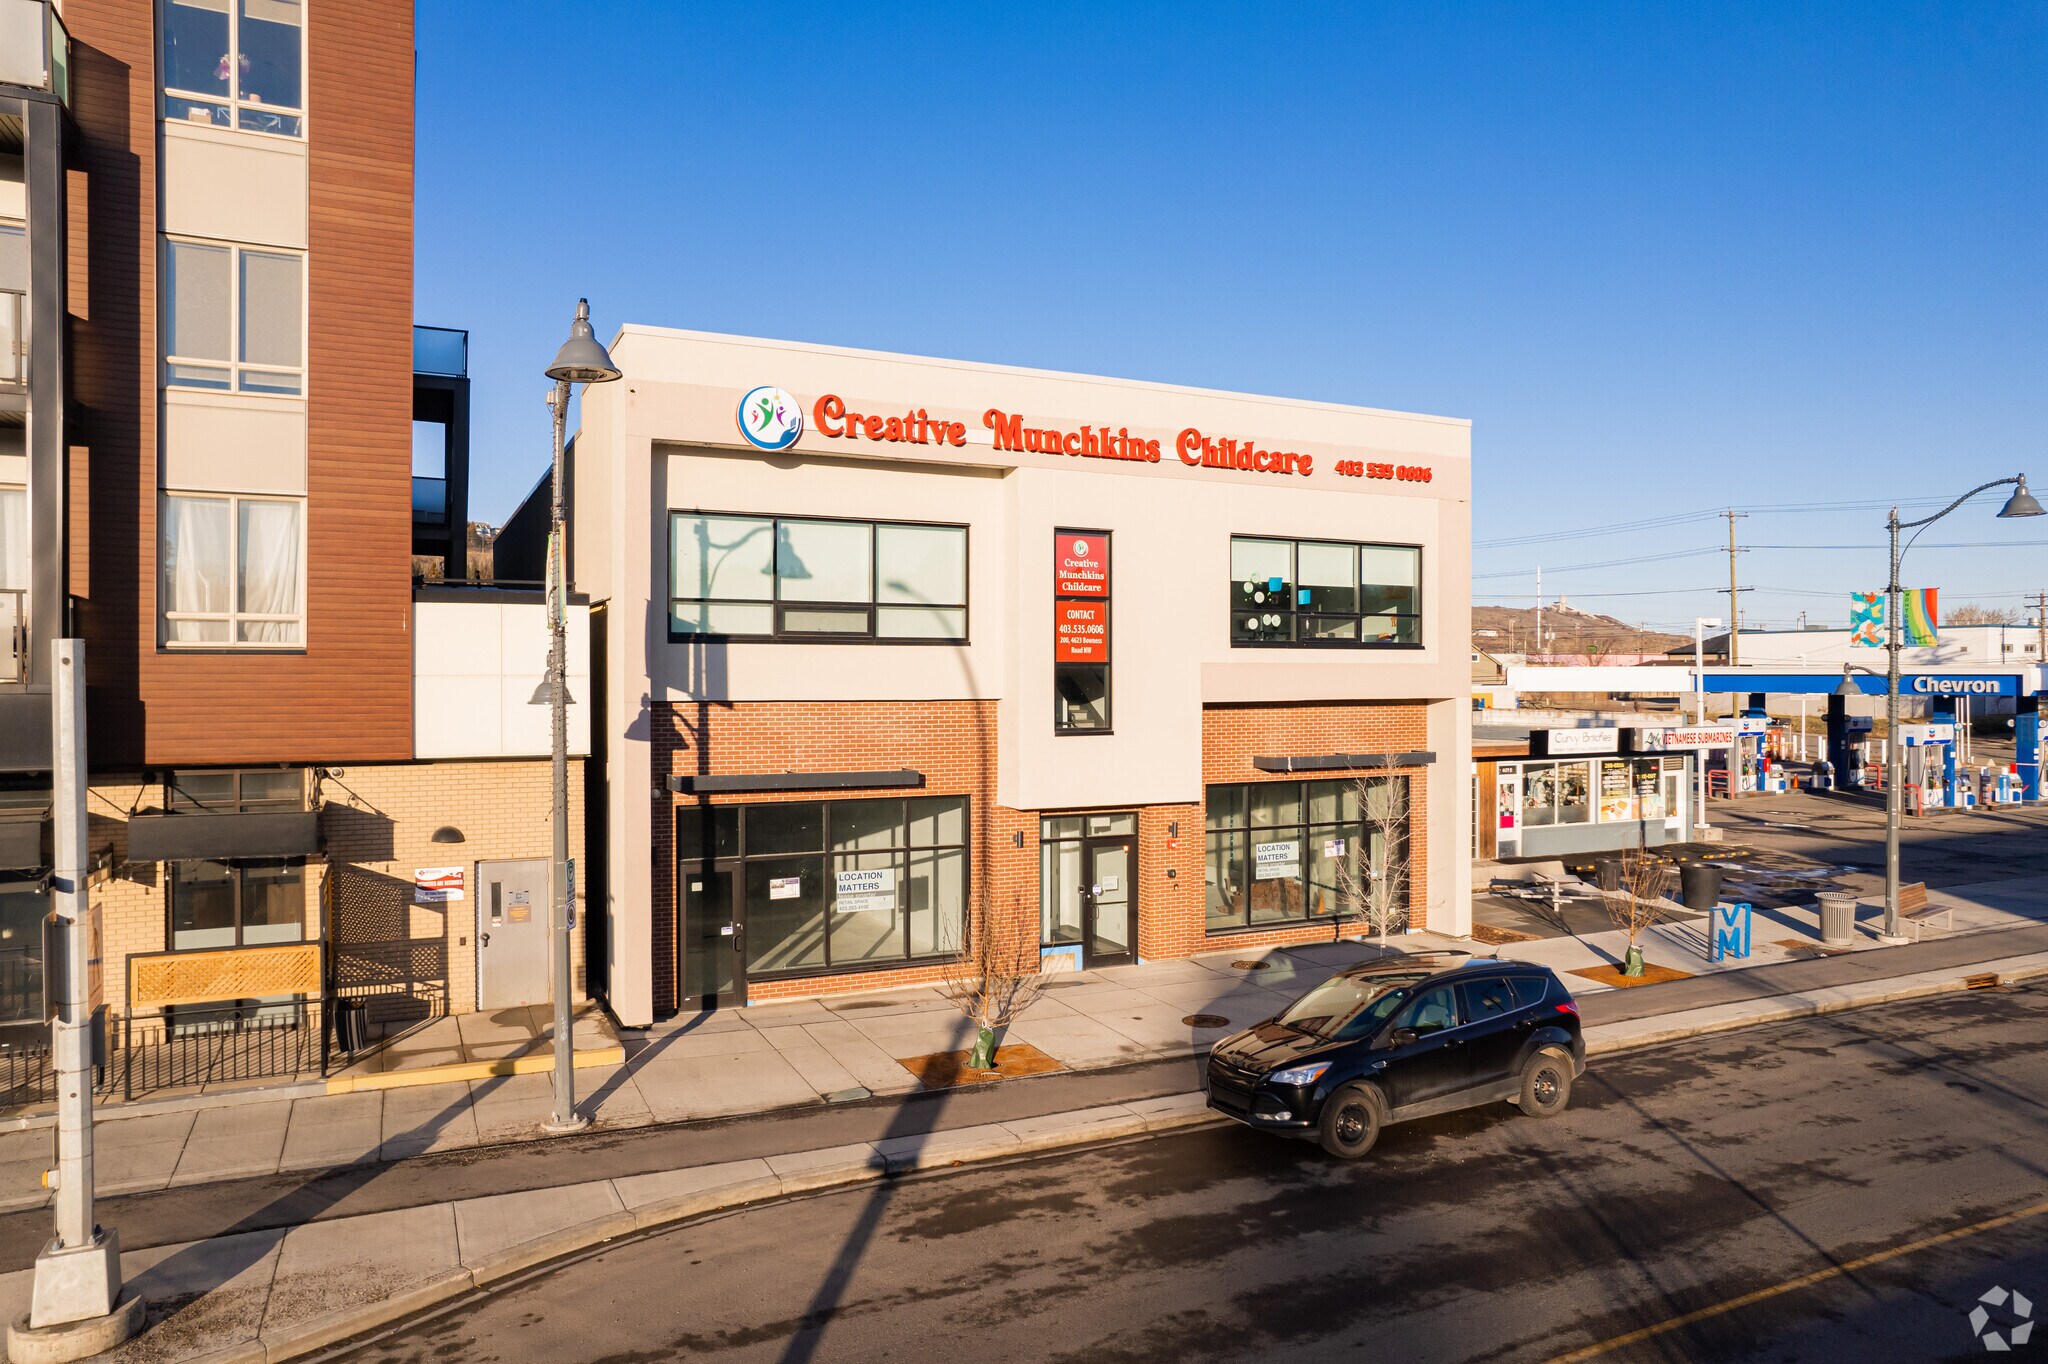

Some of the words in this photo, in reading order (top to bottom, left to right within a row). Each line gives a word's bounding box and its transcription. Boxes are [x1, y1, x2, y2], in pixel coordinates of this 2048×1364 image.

[813, 394, 966, 447] Creative
[982, 408, 1161, 463] Munchkins
[1176, 428, 1314, 476] Childcare
[1335, 459, 1364, 477] 403
[1366, 462, 1394, 480] 535
[1396, 465, 1433, 483] 0606
[1064, 558, 1099, 568] Creative
[1059, 570, 1105, 580] Munchkins
[1062, 582, 1102, 592] Childcare
[1067, 609, 1095, 620] CONTACT
[1059, 624, 1104, 635] 403.535.0606
[1071, 646, 1083, 654] Road
[1083, 646, 1092, 654] NW
[1914, 676, 2000, 693] Chevron
[1662, 732, 1696, 745] VIETNAMESE
[1698, 731, 1732, 743] SUBMARINES
[1258, 844, 1290, 852] LOCATION
[1258, 853, 1288, 861] MATTERS
[839, 872, 883, 881] LOCATION
[839, 882, 880, 892] MATTERS
